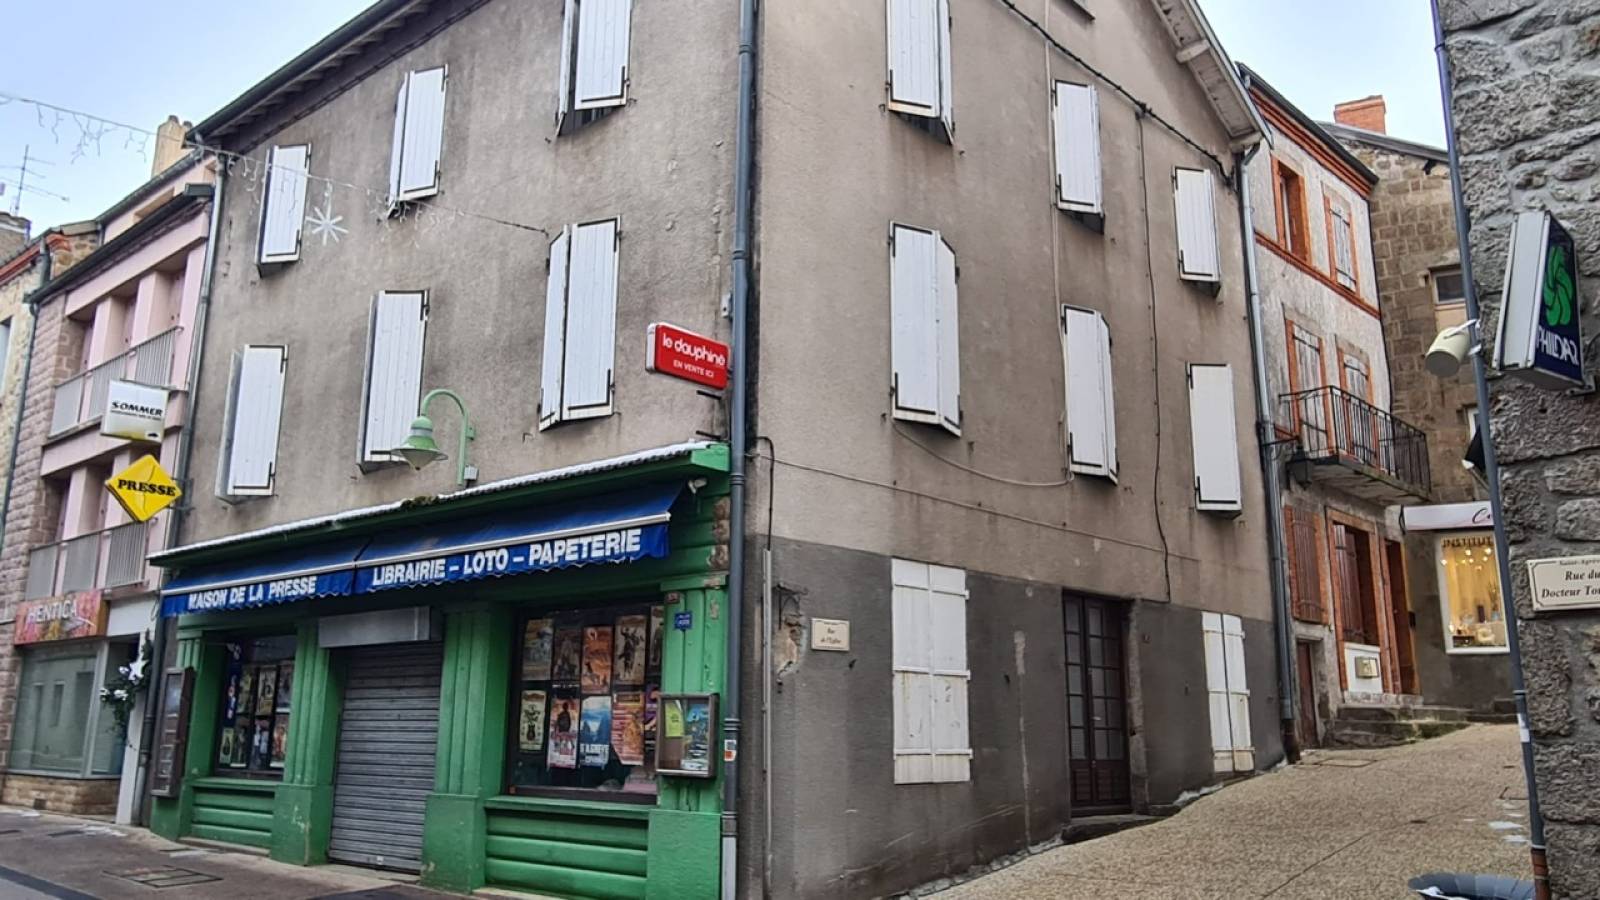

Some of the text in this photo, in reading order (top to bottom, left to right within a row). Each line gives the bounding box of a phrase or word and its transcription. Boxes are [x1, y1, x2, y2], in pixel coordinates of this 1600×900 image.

[662, 332, 674, 349] le
[673, 360, 683, 369] EN
[685, 363, 705, 376] VENTE
[112, 400, 163, 417] SOMMER
[118, 478, 176, 497] PRESSE
[372, 559, 446, 587] LIBRAIRIE
[463, 548, 509, 575] LOTO
[528, 529, 641, 566] PAPETERIE
[1565, 571, 1584, 581] Rue
[188, 576, 317, 610] MAISON DE LA PRESSE
[1541, 588, 1580, 598] Docteur
